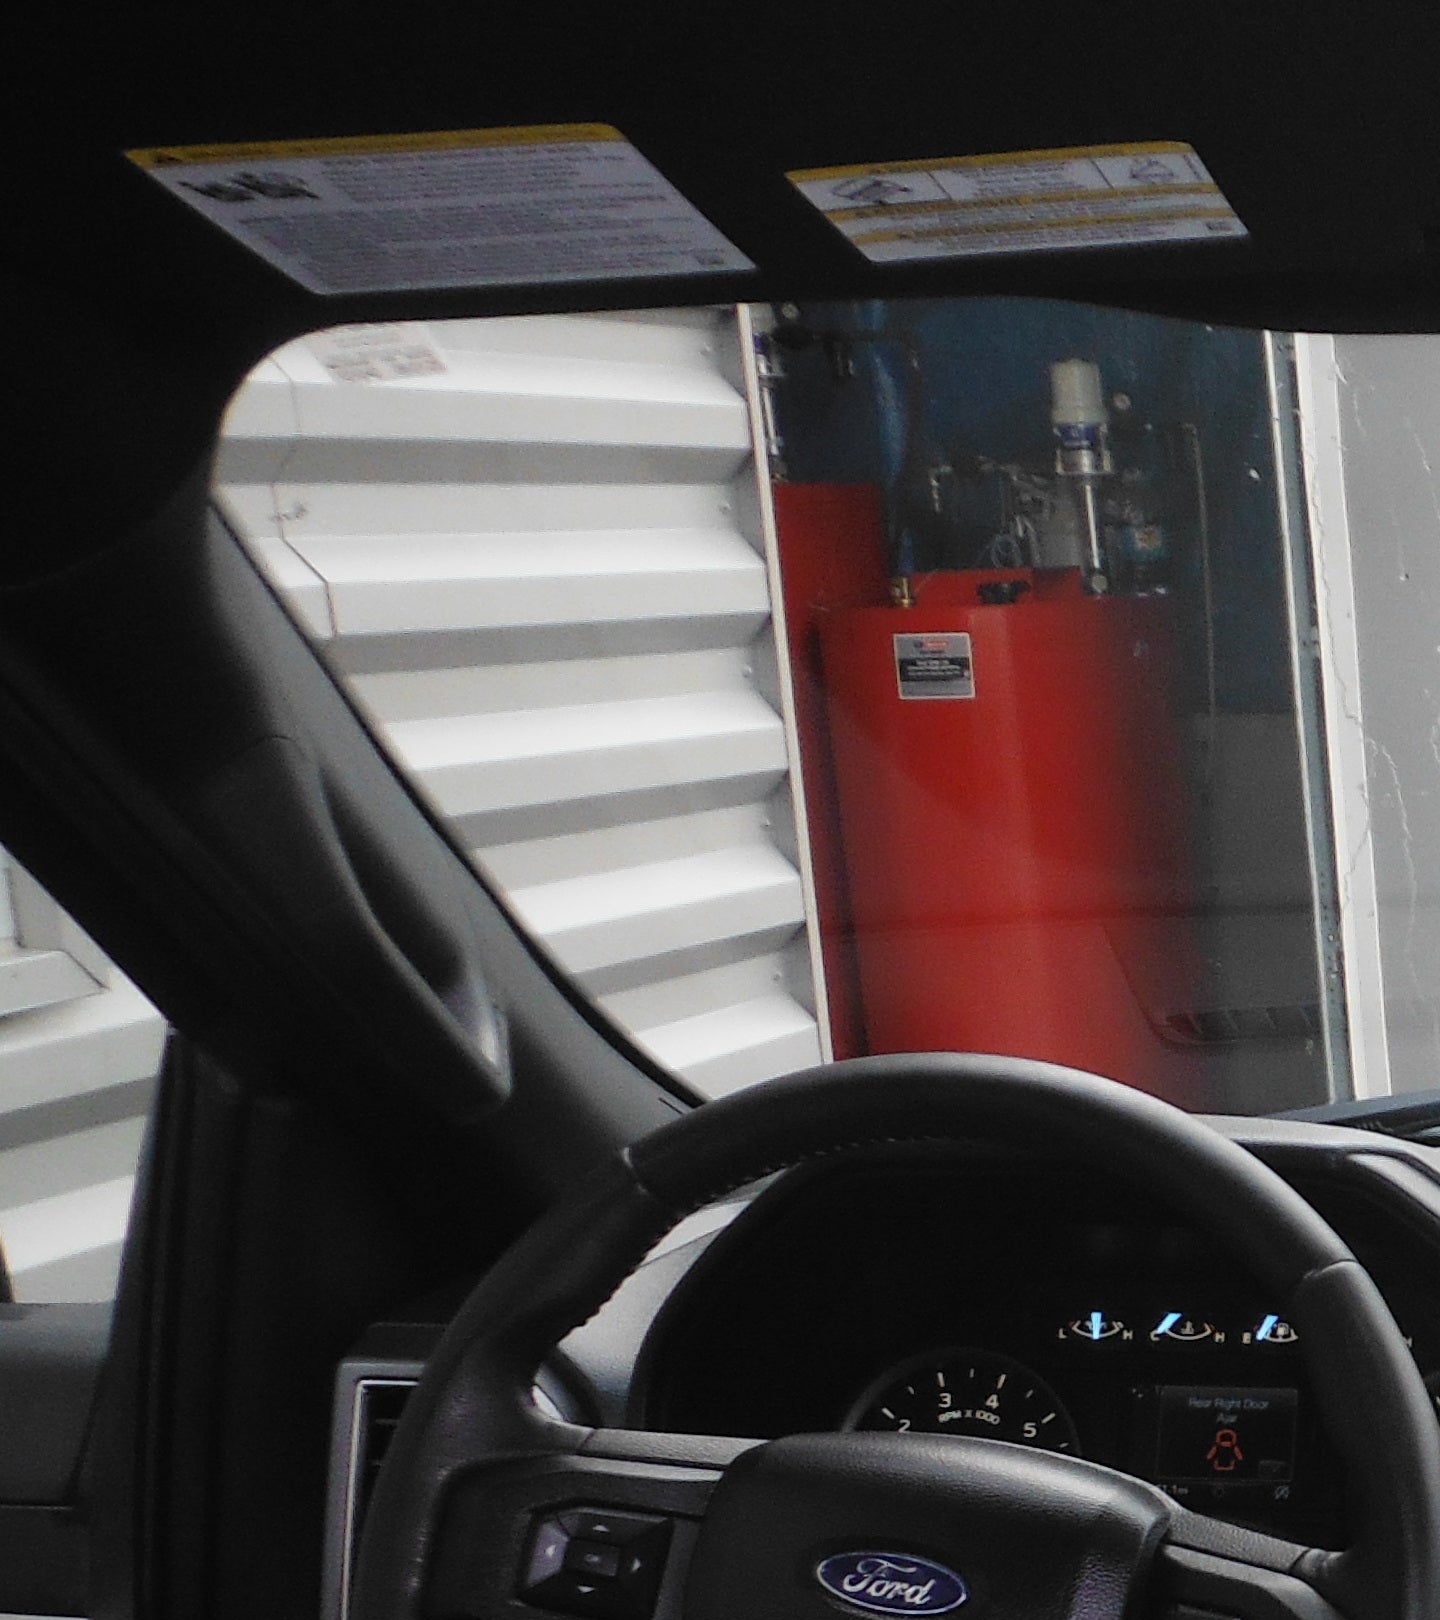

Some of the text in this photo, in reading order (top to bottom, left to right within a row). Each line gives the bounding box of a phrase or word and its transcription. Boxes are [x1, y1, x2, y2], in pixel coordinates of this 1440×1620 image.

[1122, 1329, 1134, 1341] H
[1215, 1332, 1226, 1344] H
[938, 1392, 952, 1409] 3
[985, 1393, 1000, 1410] 4
[898, 1418, 911, 1432] 2
[1022, 1421, 1038, 1439] 5
[843, 1557, 936, 1605] Ford
